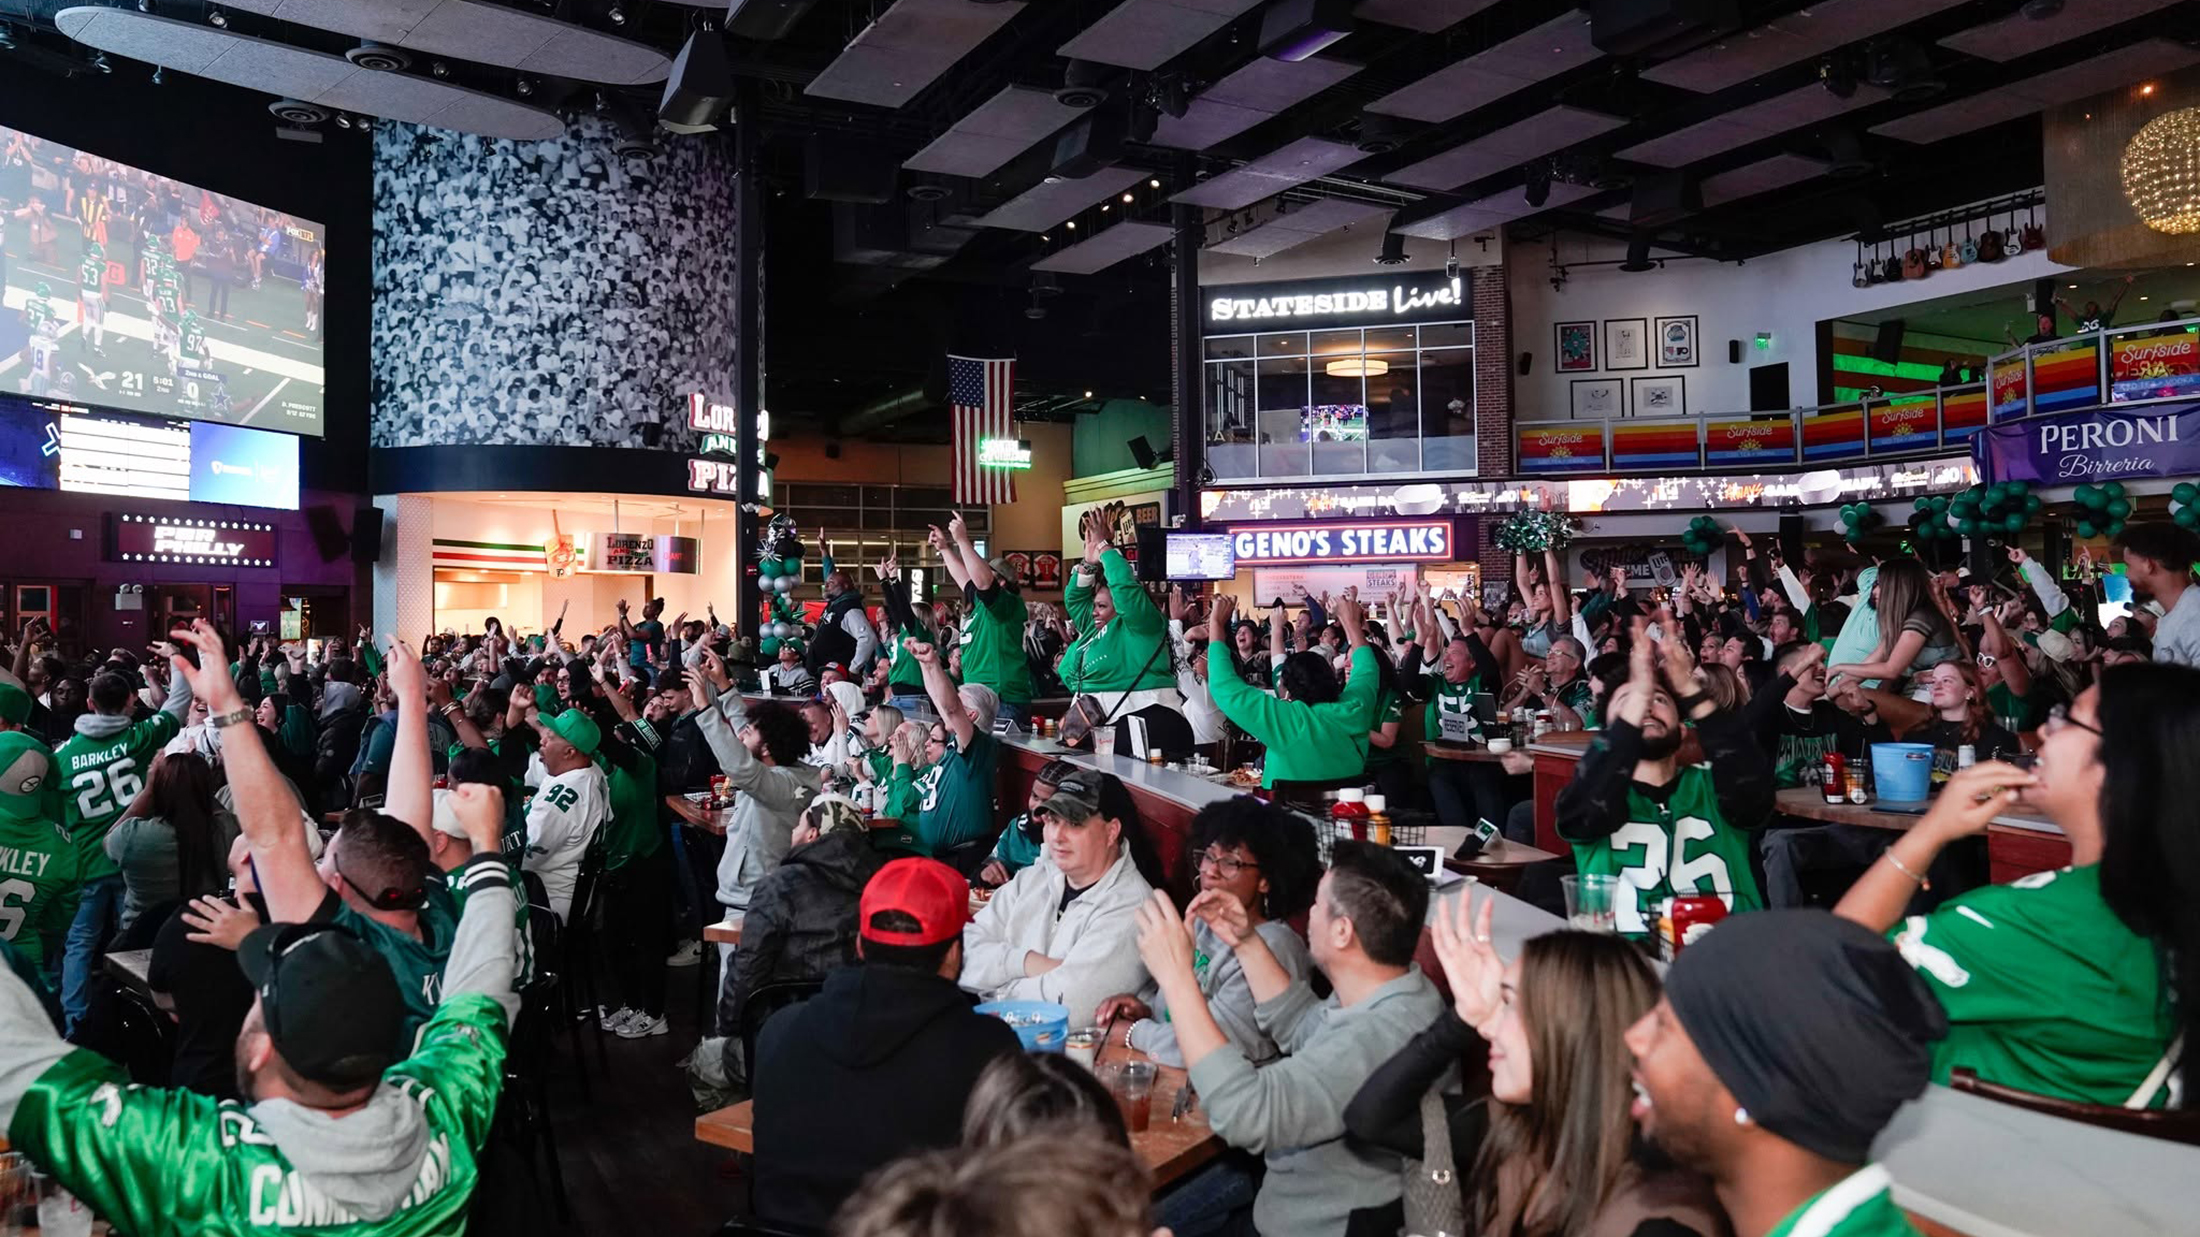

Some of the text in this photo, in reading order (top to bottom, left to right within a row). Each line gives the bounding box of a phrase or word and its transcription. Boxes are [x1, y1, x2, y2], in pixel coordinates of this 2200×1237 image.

[1211, 278, 1462, 321] STATESIDE Live!
[2121, 340, 2191, 364] Surfside
[121, 371, 143, 390] 21
[187, 382, 199, 399] 0
[1882, 407, 1925, 424] Surfside
[1539, 432, 1583, 446] Surfside
[1727, 424, 1773, 439] Surfside
[2040, 416, 2179, 455] PERONI
[691, 460, 770, 497] PIA
[2059, 454, 2155, 479] Birreria
[1136, 506, 1159, 524] BEER
[154, 539, 245, 556] PHILLY
[607, 537, 654, 549] LORENZO
[1235, 527, 1445, 559] GENO'S STEAKS
[607, 556, 653, 566] PIZZA
[1368, 579, 1396, 587] STEAKS
[71, 742, 129, 770] BARKLEY
[71, 757, 144, 820] 26
[544, 784, 579, 813] 92
[0, 846, 51, 877] KLEY
[1610, 816, 1735, 932] 26
